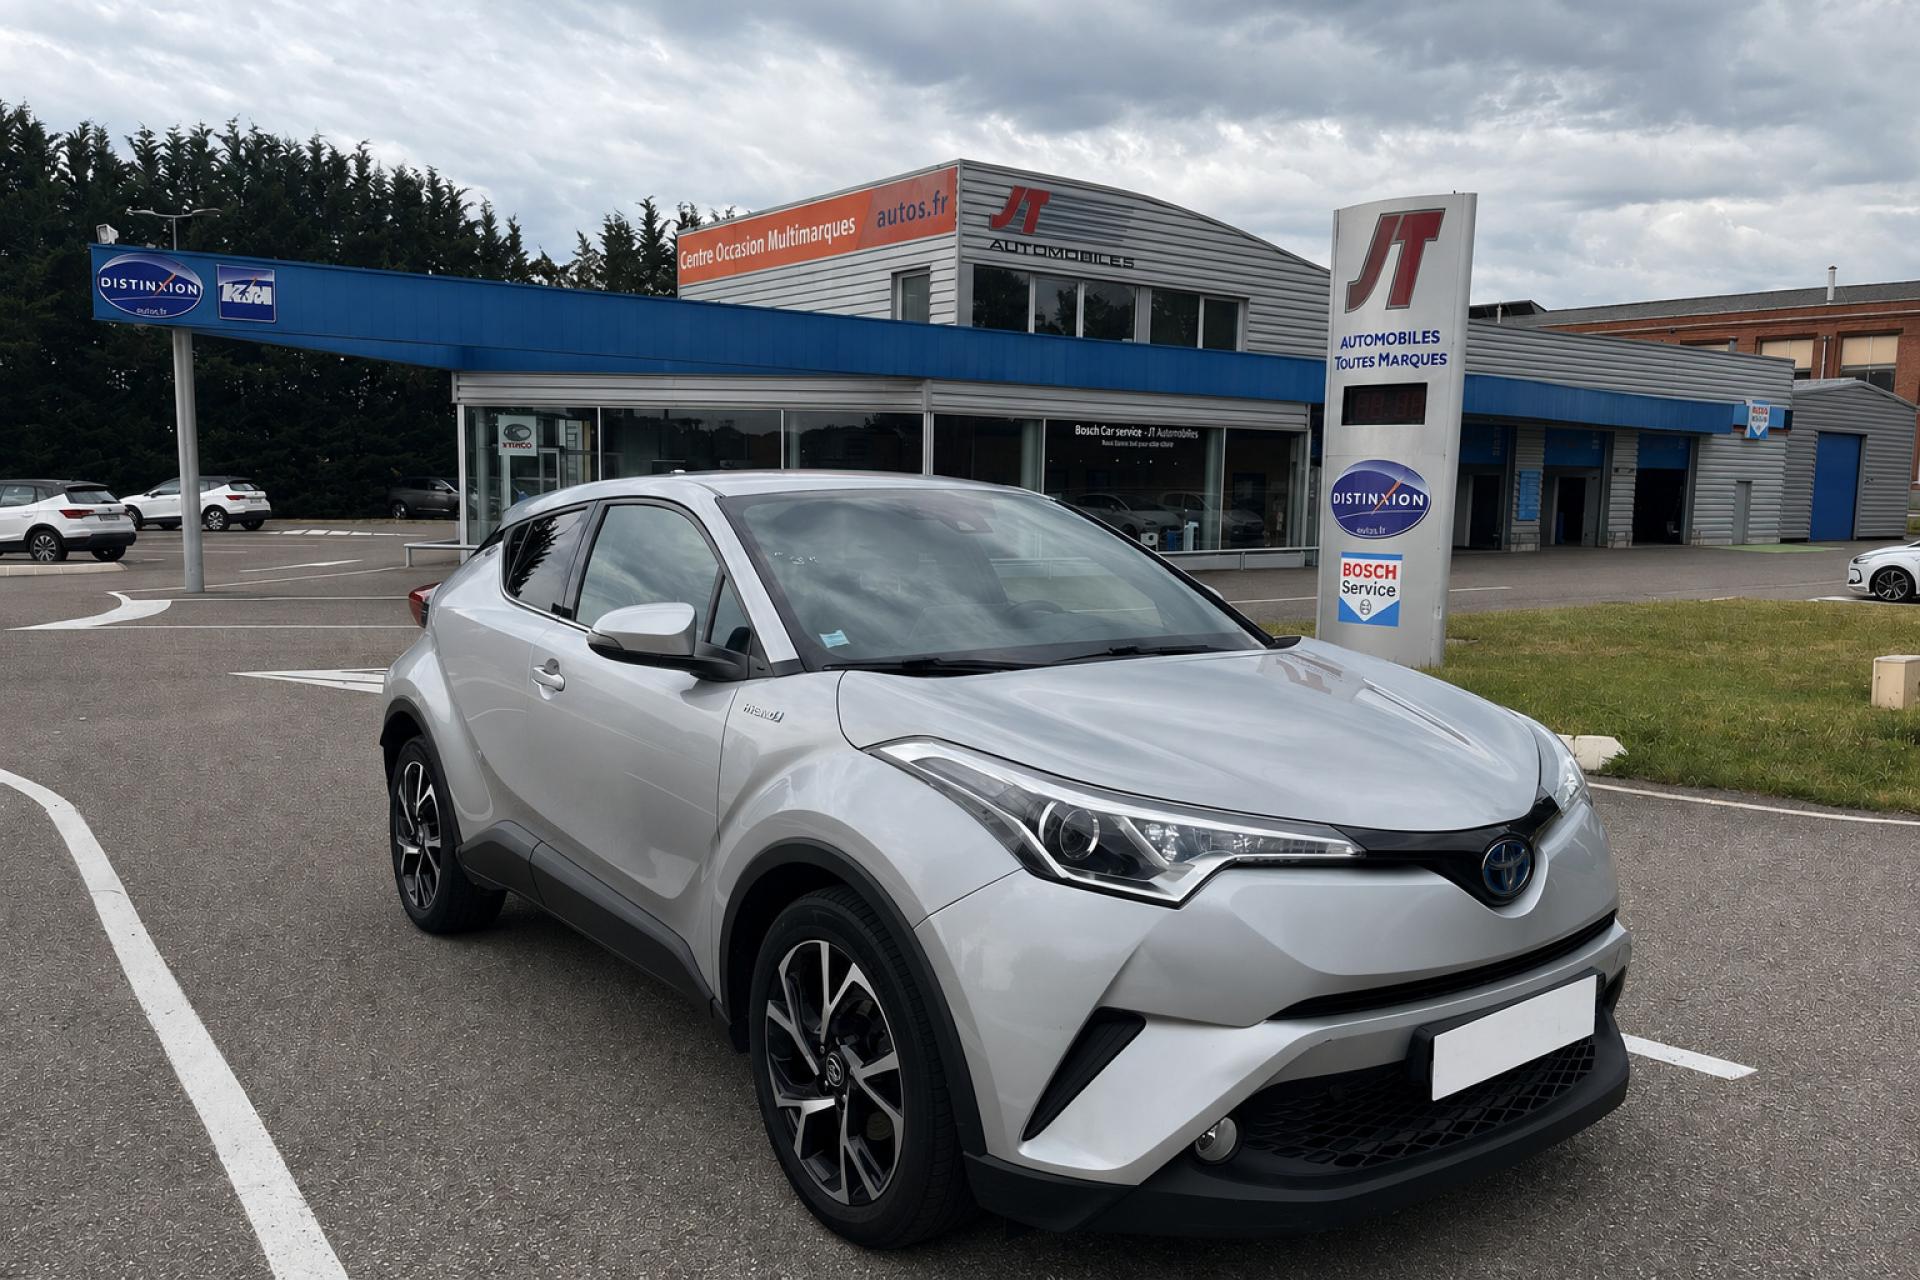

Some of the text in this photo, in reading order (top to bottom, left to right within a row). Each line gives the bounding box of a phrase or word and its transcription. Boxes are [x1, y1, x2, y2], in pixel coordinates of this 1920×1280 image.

[989, 185, 1053, 235] JT
[680, 189, 950, 270] Centre Occasion Multimarques autos.fr
[988, 238, 1136, 270] AUTOMOBILES
[1344, 208, 1446, 314] JT
[100, 272, 199, 297] DISTINXION
[1340, 330, 1441, 350] AUTOMOBILES
[1074, 424, 1100, 436] Bosch
[1333, 491, 1424, 508] DISTINXION
[1343, 562, 1397, 580] BOSCH
[1342, 579, 1396, 597] Service
